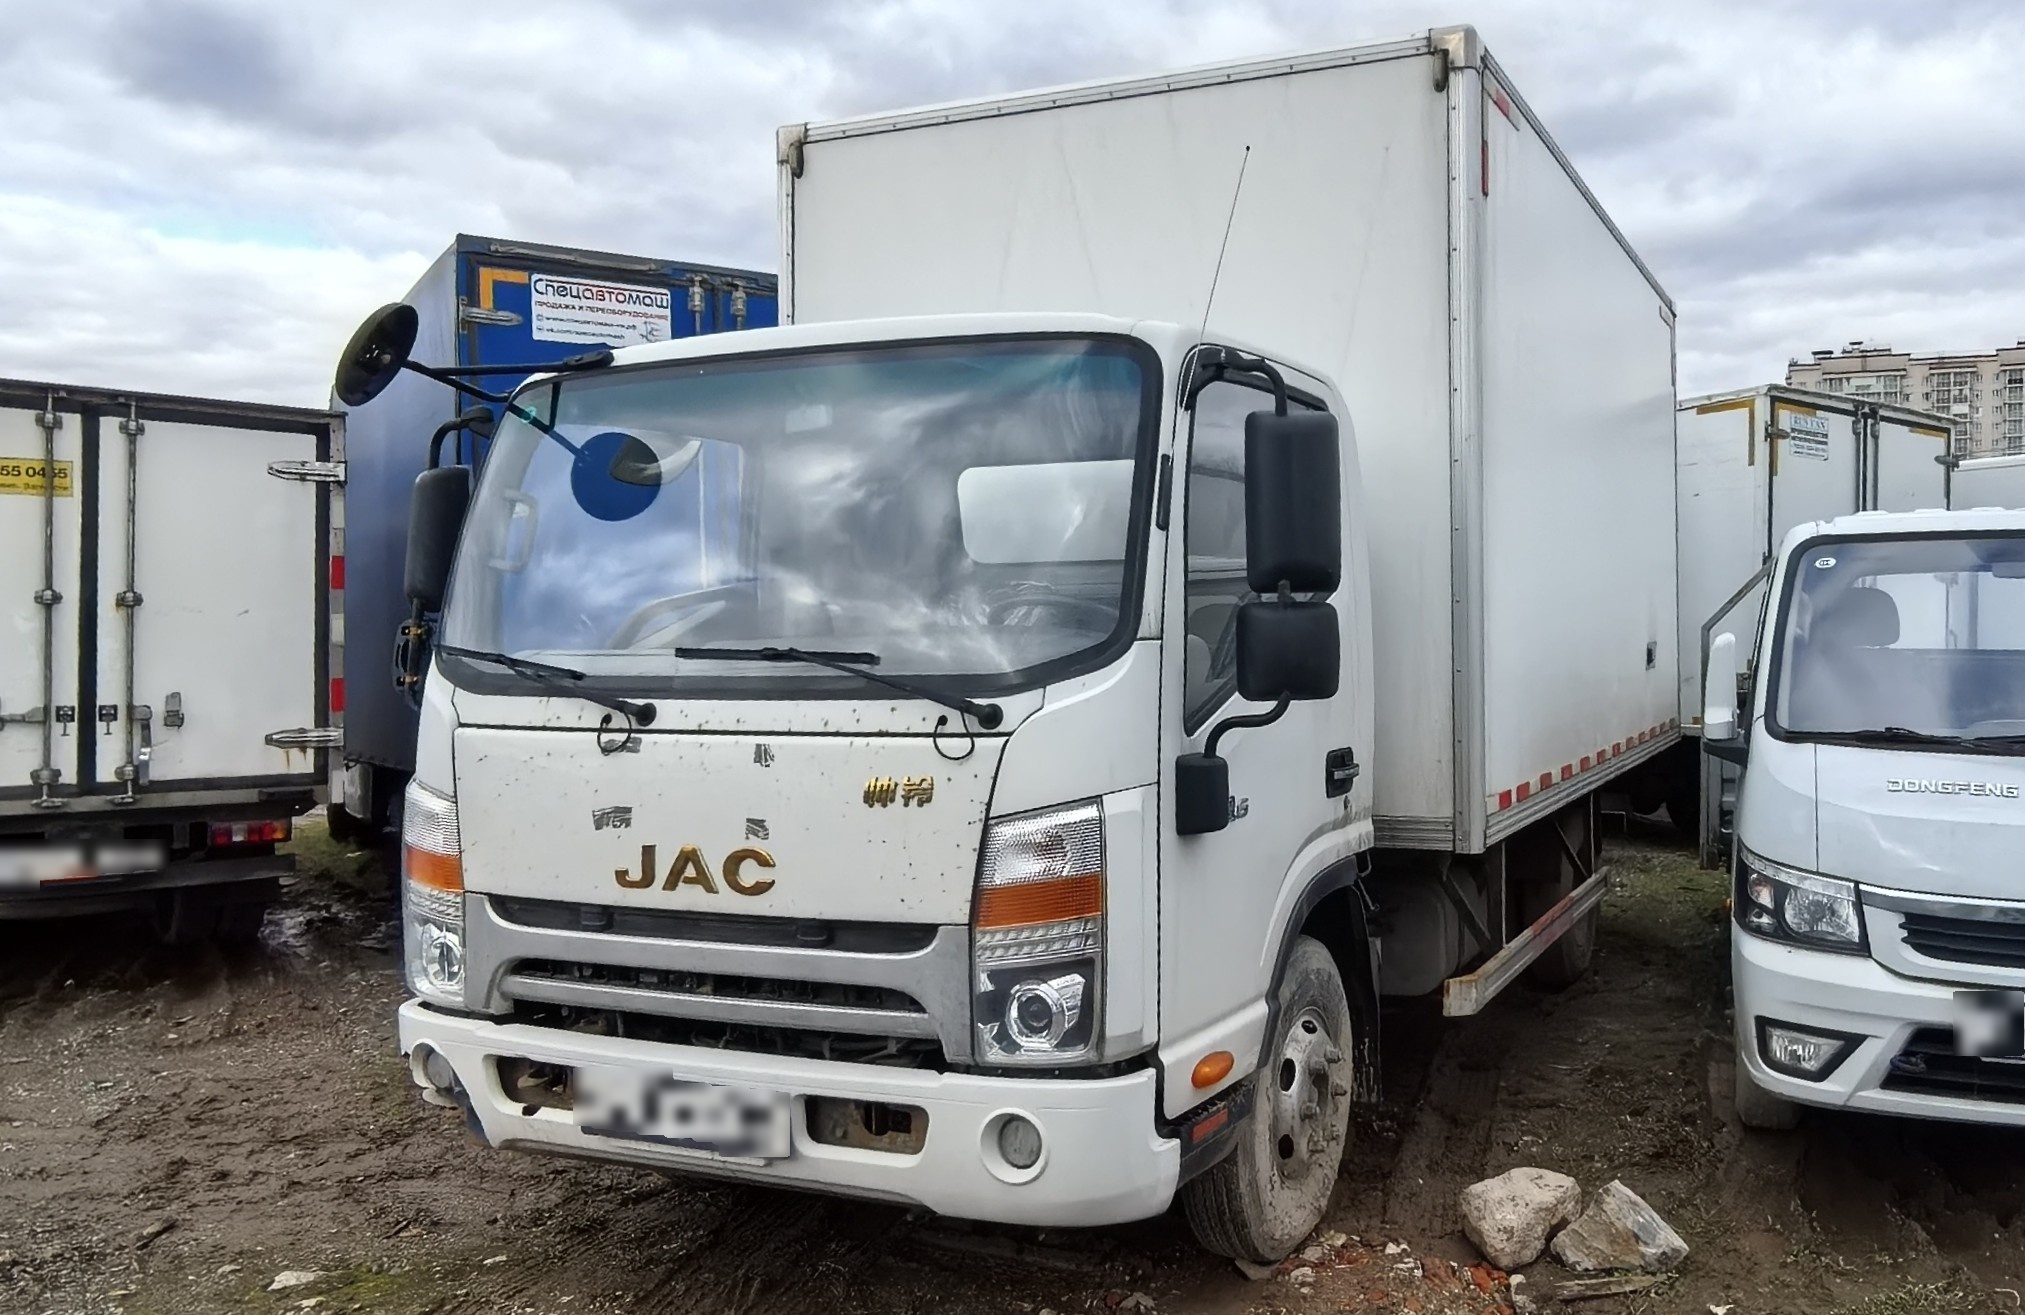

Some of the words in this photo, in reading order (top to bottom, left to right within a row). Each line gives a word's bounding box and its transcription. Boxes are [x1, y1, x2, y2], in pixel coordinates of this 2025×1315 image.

[533, 278, 669, 309] Спецавтомаш
[535, 301, 576, 311] ПРОДАЖА
[1886, 779, 2019, 798] DONGFENG
[615, 843, 777, 896] JAC
